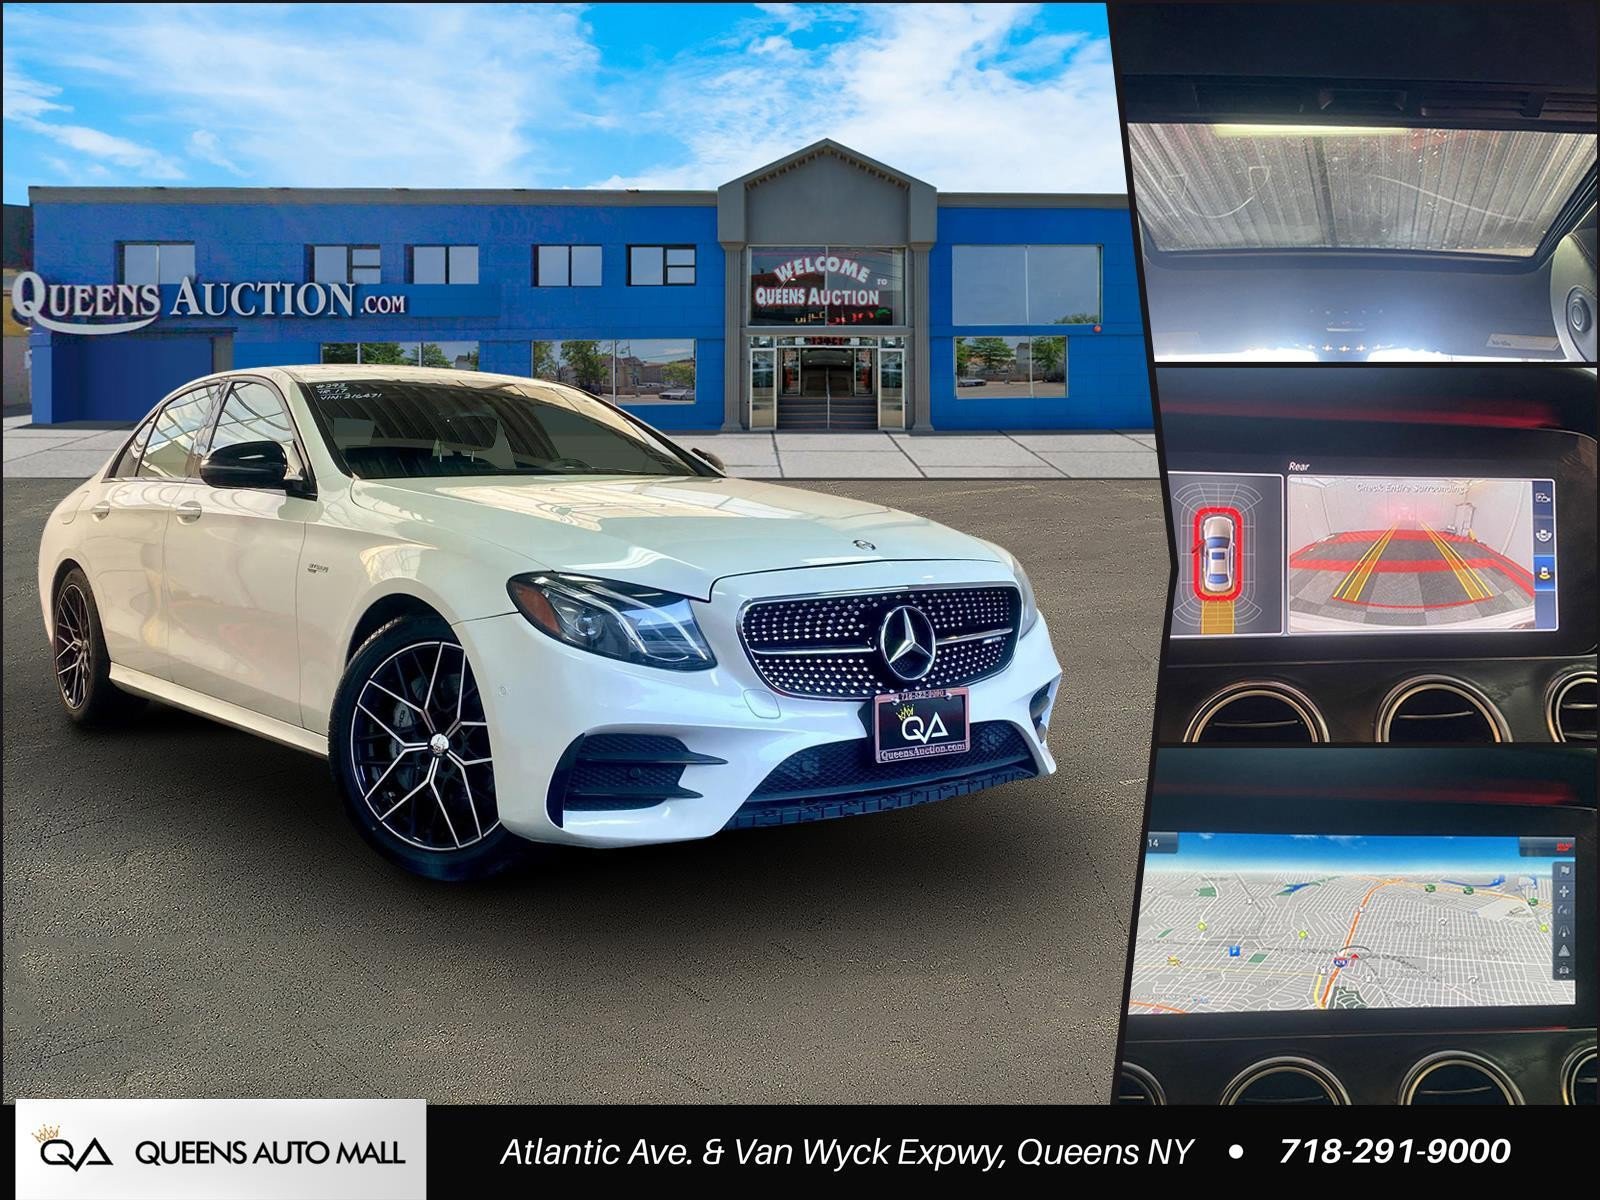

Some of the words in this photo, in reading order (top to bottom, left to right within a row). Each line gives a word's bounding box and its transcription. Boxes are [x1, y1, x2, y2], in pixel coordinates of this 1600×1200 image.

[774, 256, 871, 284] WELCOME
[877, 278, 888, 286] TO
[11, 271, 162, 335] QUEENS
[755, 287, 805, 307] QUEENS
[807, 288, 880, 306] AUCTION
[1289, 461, 1310, 471] Rear
[1357, 483, 1385, 493] Check
[901, 711, 950, 745] QA
[880, 742, 966, 760] QueensAuction.com
